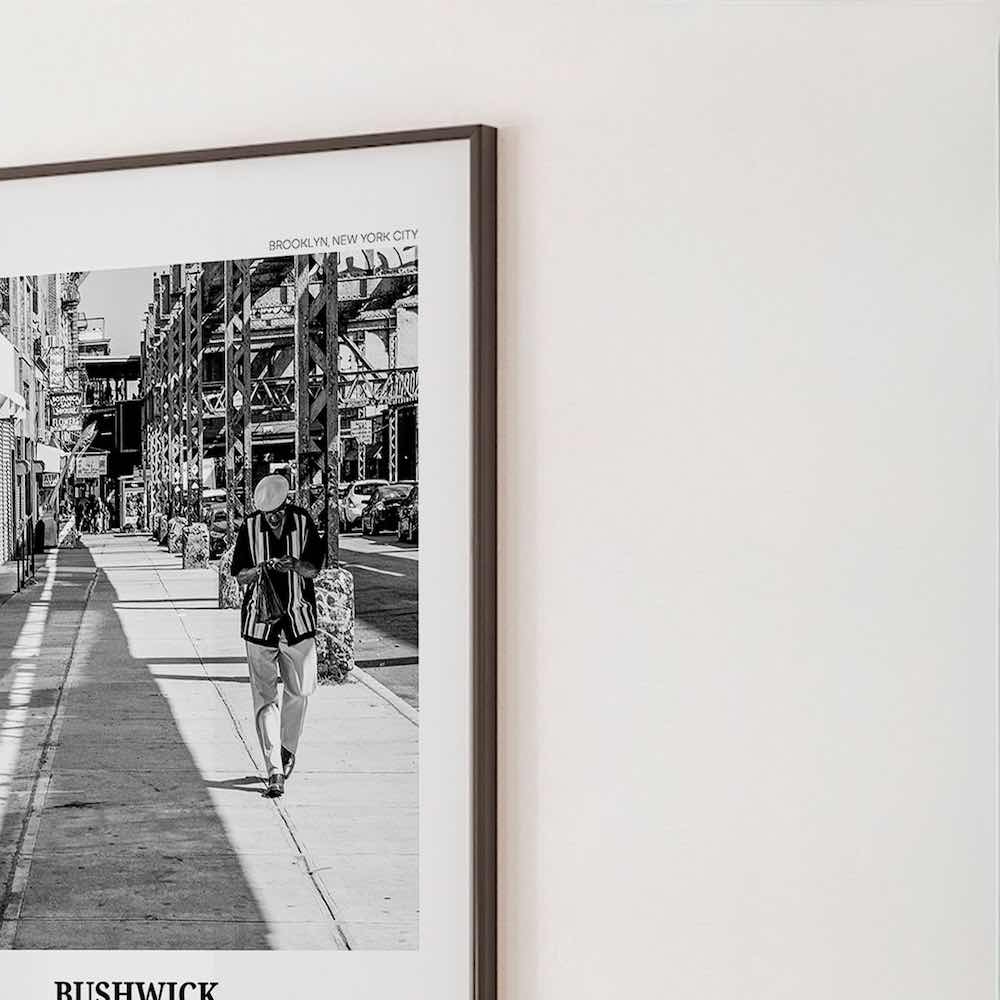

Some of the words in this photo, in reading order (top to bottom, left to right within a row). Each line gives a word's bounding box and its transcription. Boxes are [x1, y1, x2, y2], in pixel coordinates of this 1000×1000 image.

[269, 237, 330, 250] BROOKLYN,
[332, 234, 358, 246] NEW
[360, 231, 391, 244] YORK
[393, 229, 418, 241] CITY
